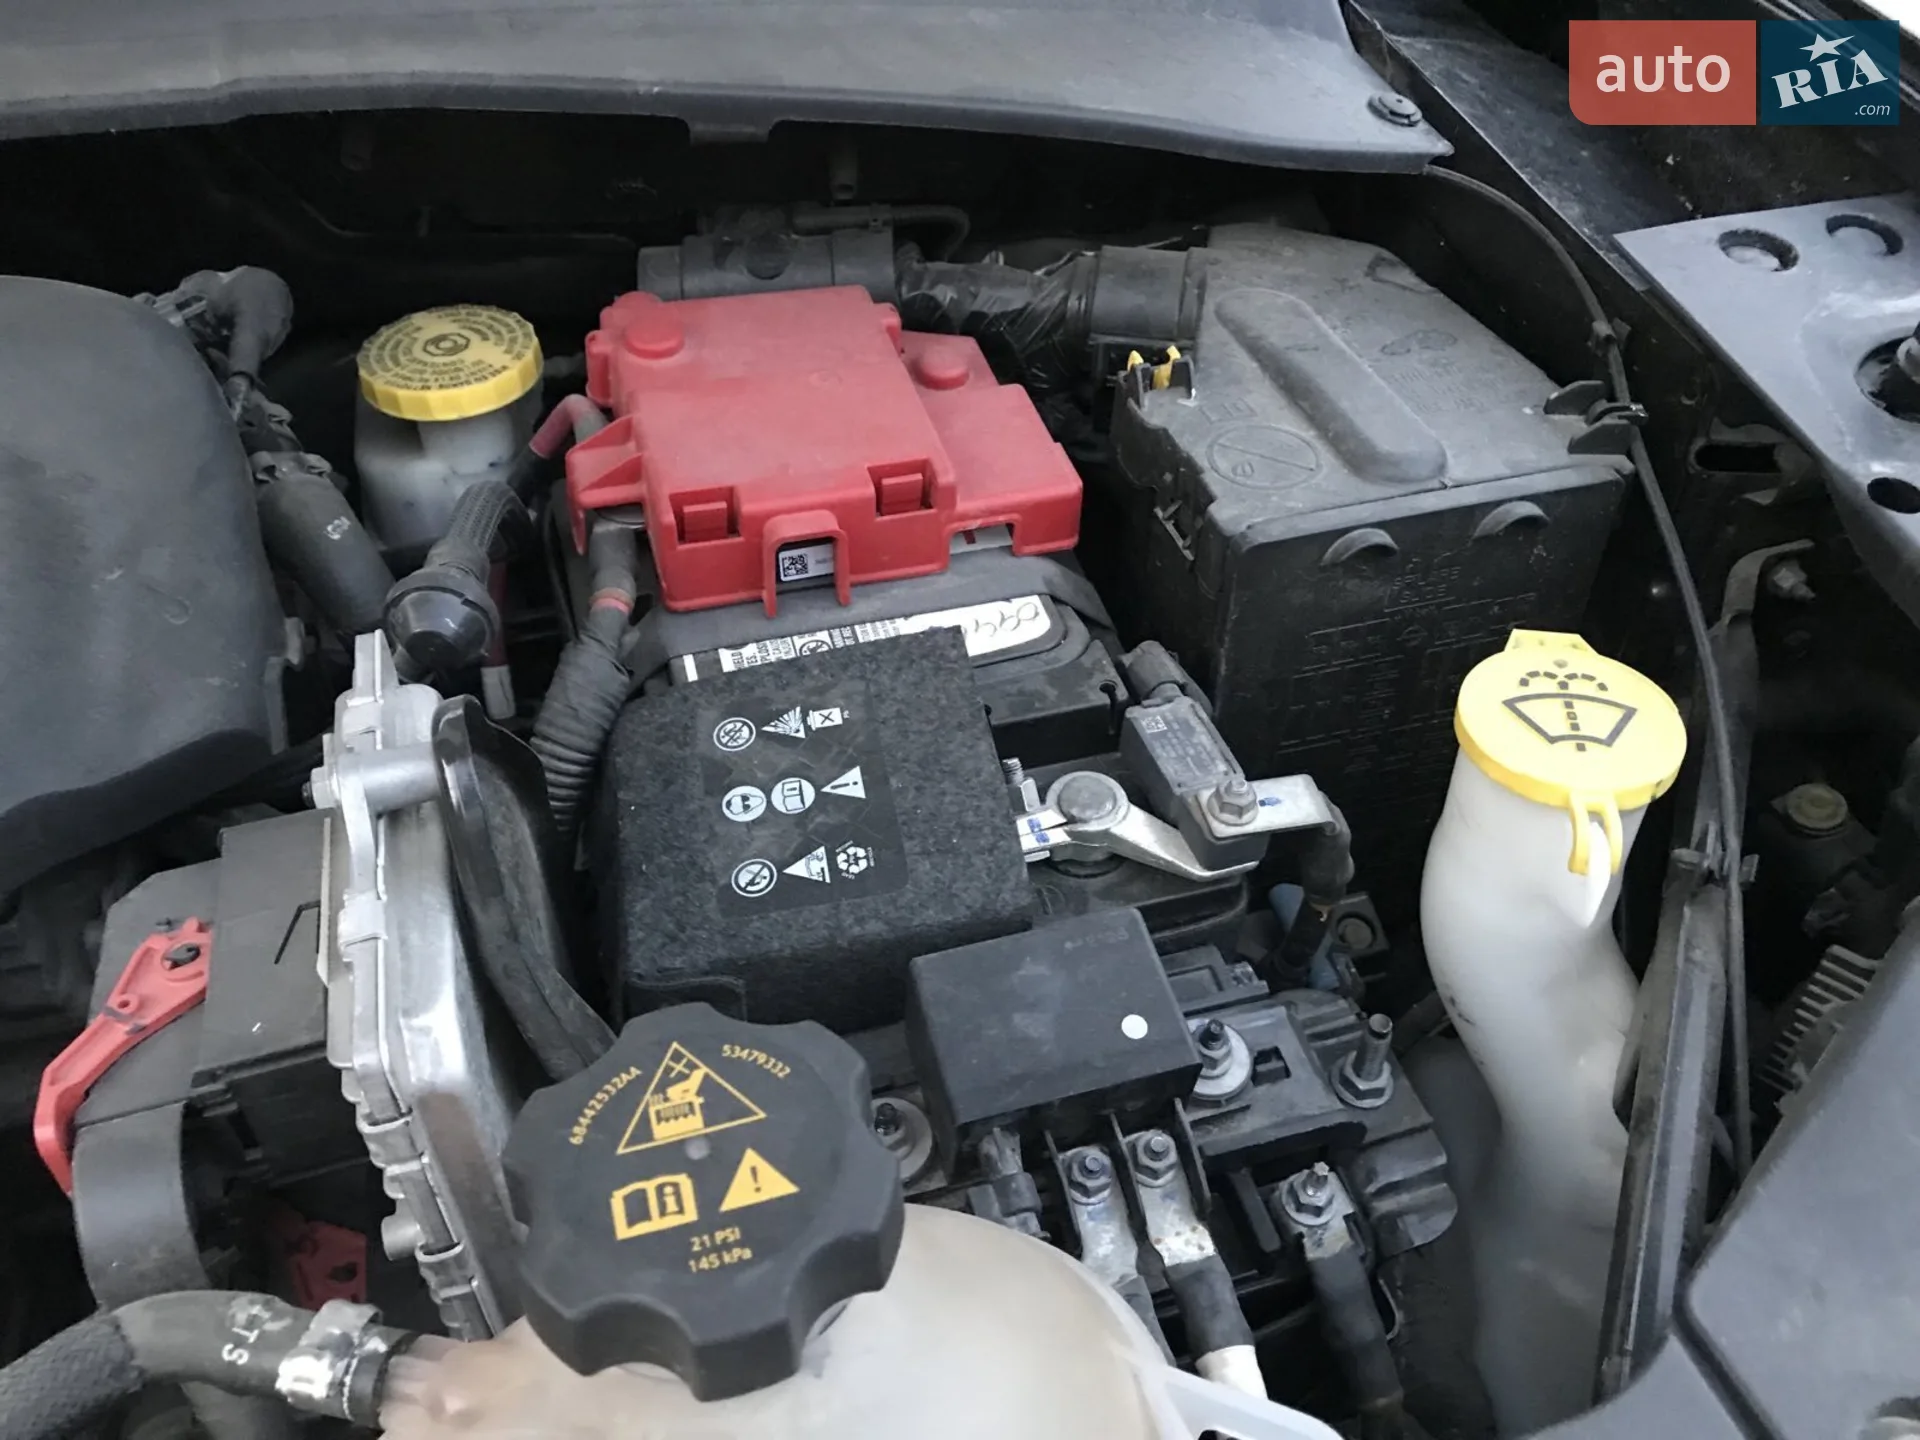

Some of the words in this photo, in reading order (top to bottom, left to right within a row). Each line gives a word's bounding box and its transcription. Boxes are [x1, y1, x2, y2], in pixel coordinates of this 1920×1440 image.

[721, 1043, 791, 1079] 53479332
[568, 1066, 643, 1146] 68442532AA
[690, 1234, 711, 1252] 21
[714, 1226, 741, 1245] PSI
[688, 1252, 721, 1273] 145
[722, 1247, 753, 1265] kPa
